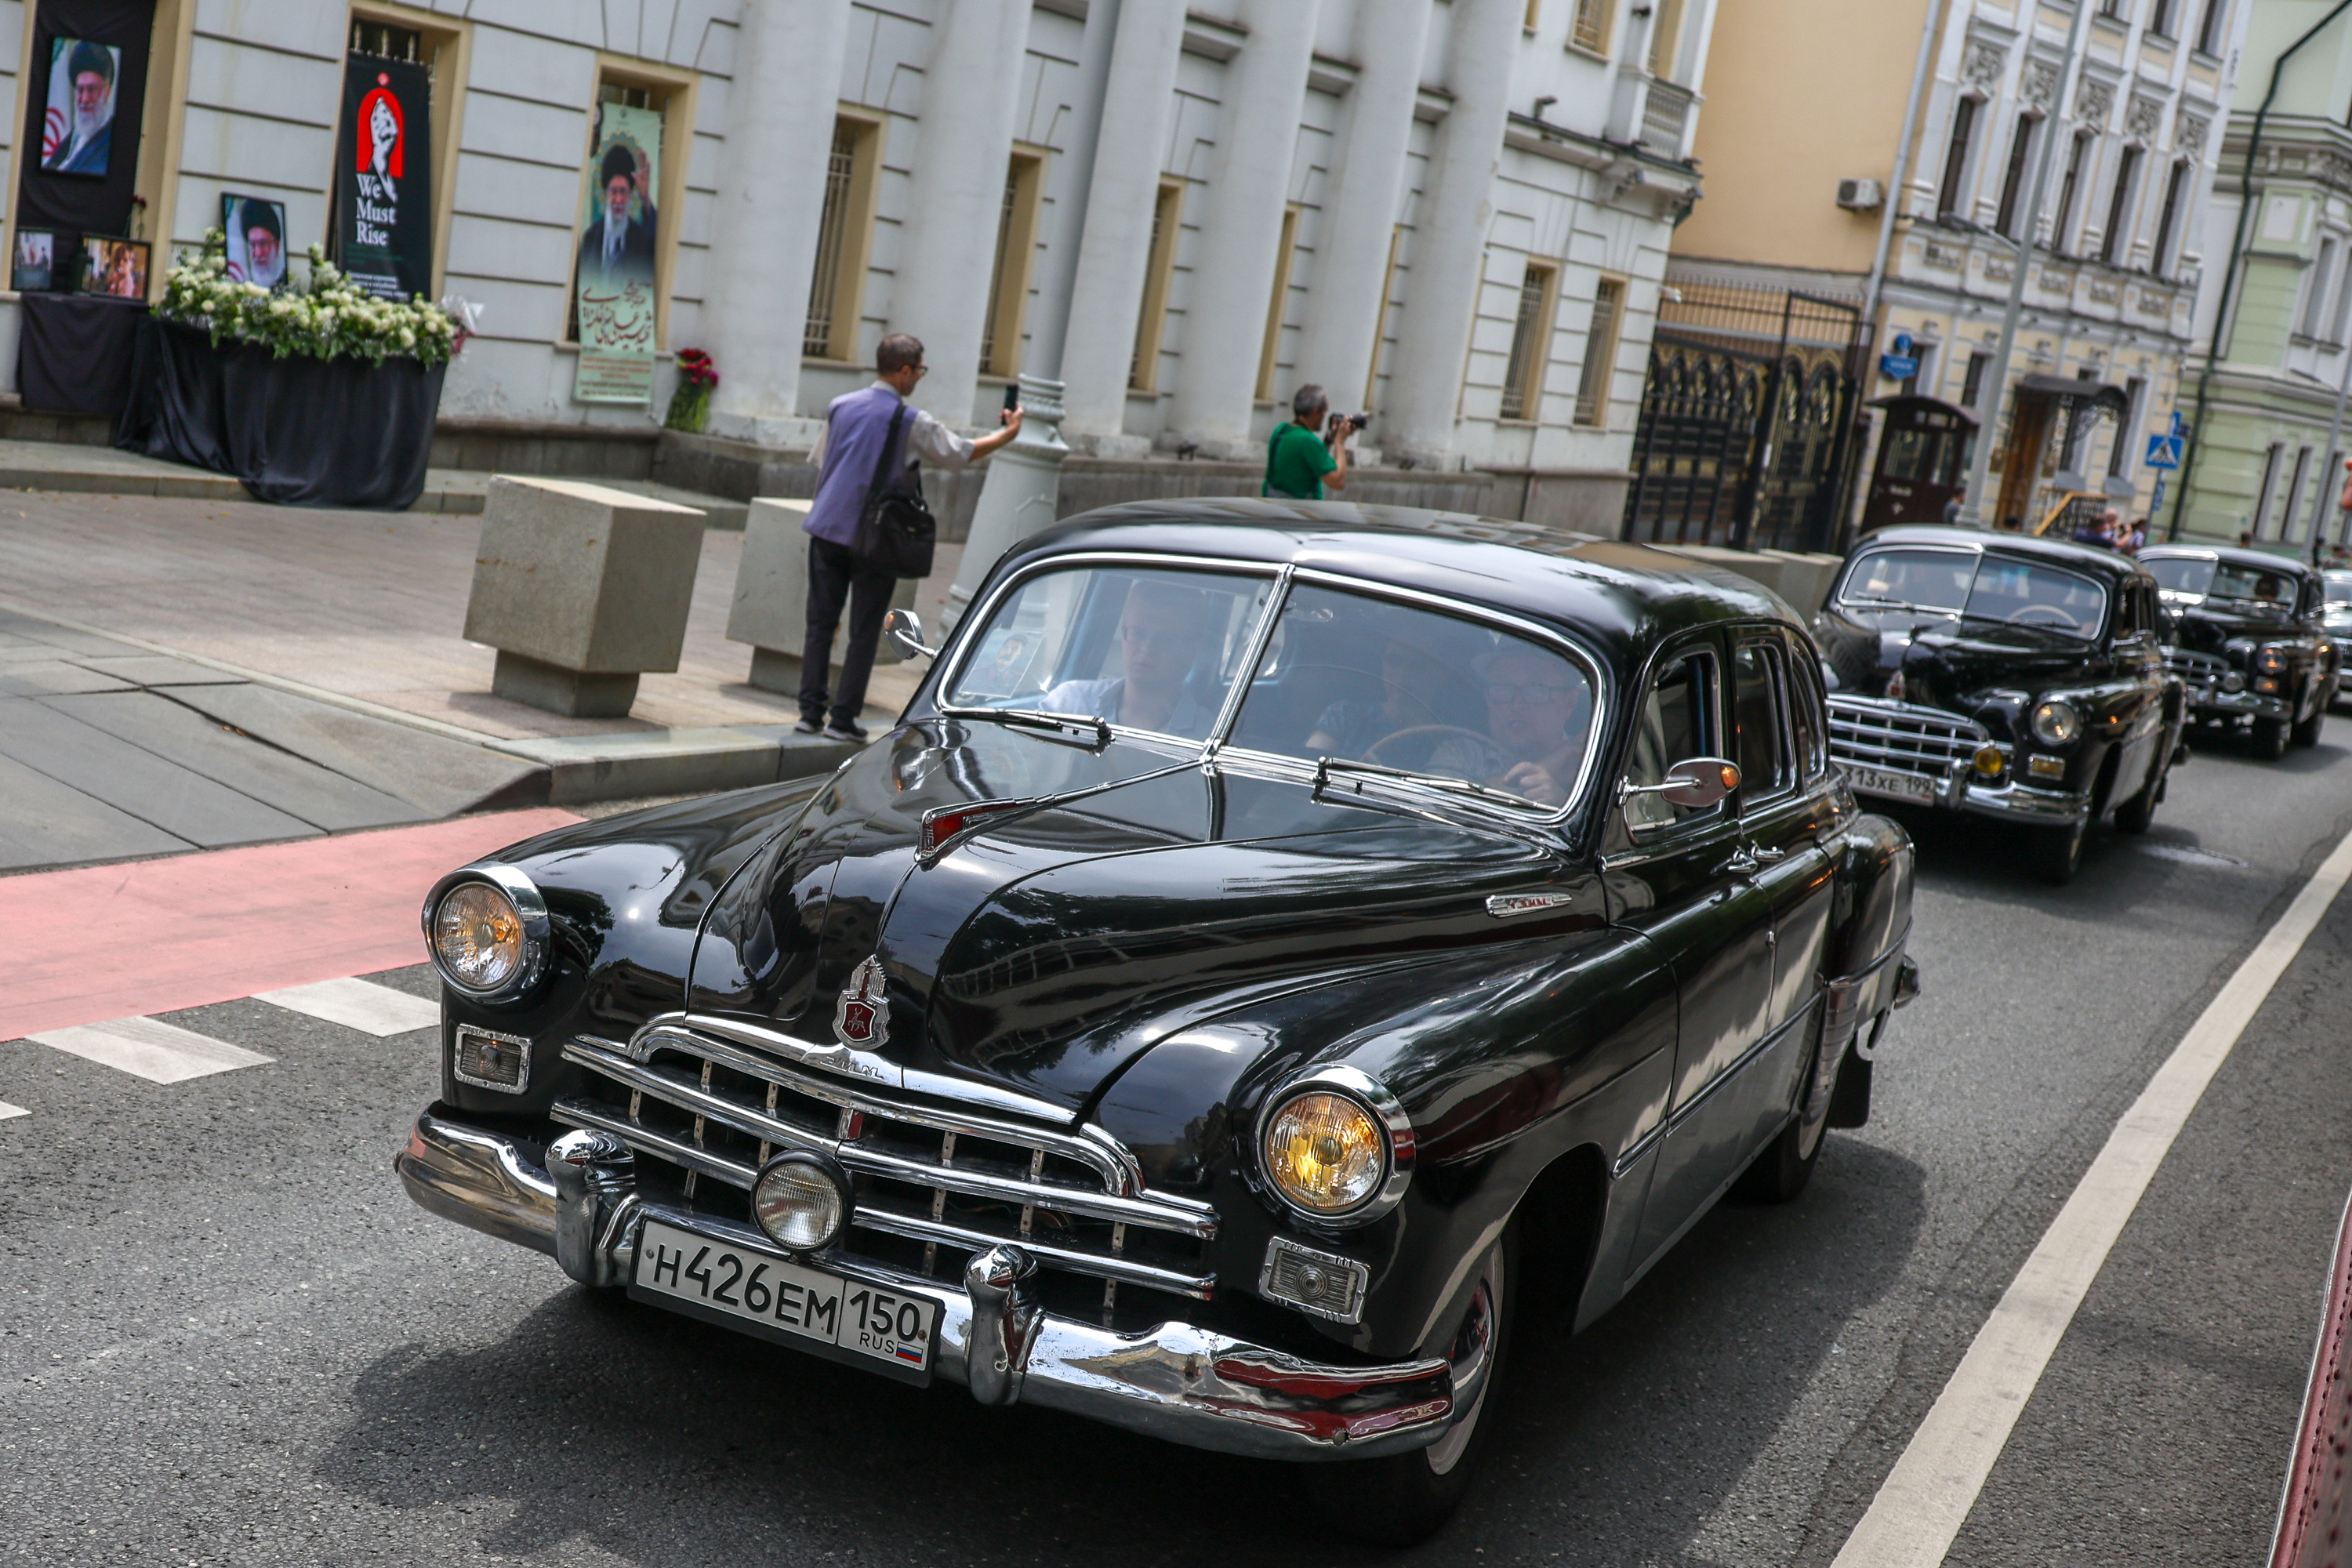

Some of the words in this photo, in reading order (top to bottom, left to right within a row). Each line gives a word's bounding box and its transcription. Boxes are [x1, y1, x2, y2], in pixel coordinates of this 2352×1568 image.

[356, 172, 383, 199] We
[356, 197, 397, 225] Must
[356, 220, 389, 247] Rise
[653, 1243, 838, 1335] Н426ЕМ
[849, 1290, 921, 1341] 150
[859, 1332, 895, 1355] RUS
